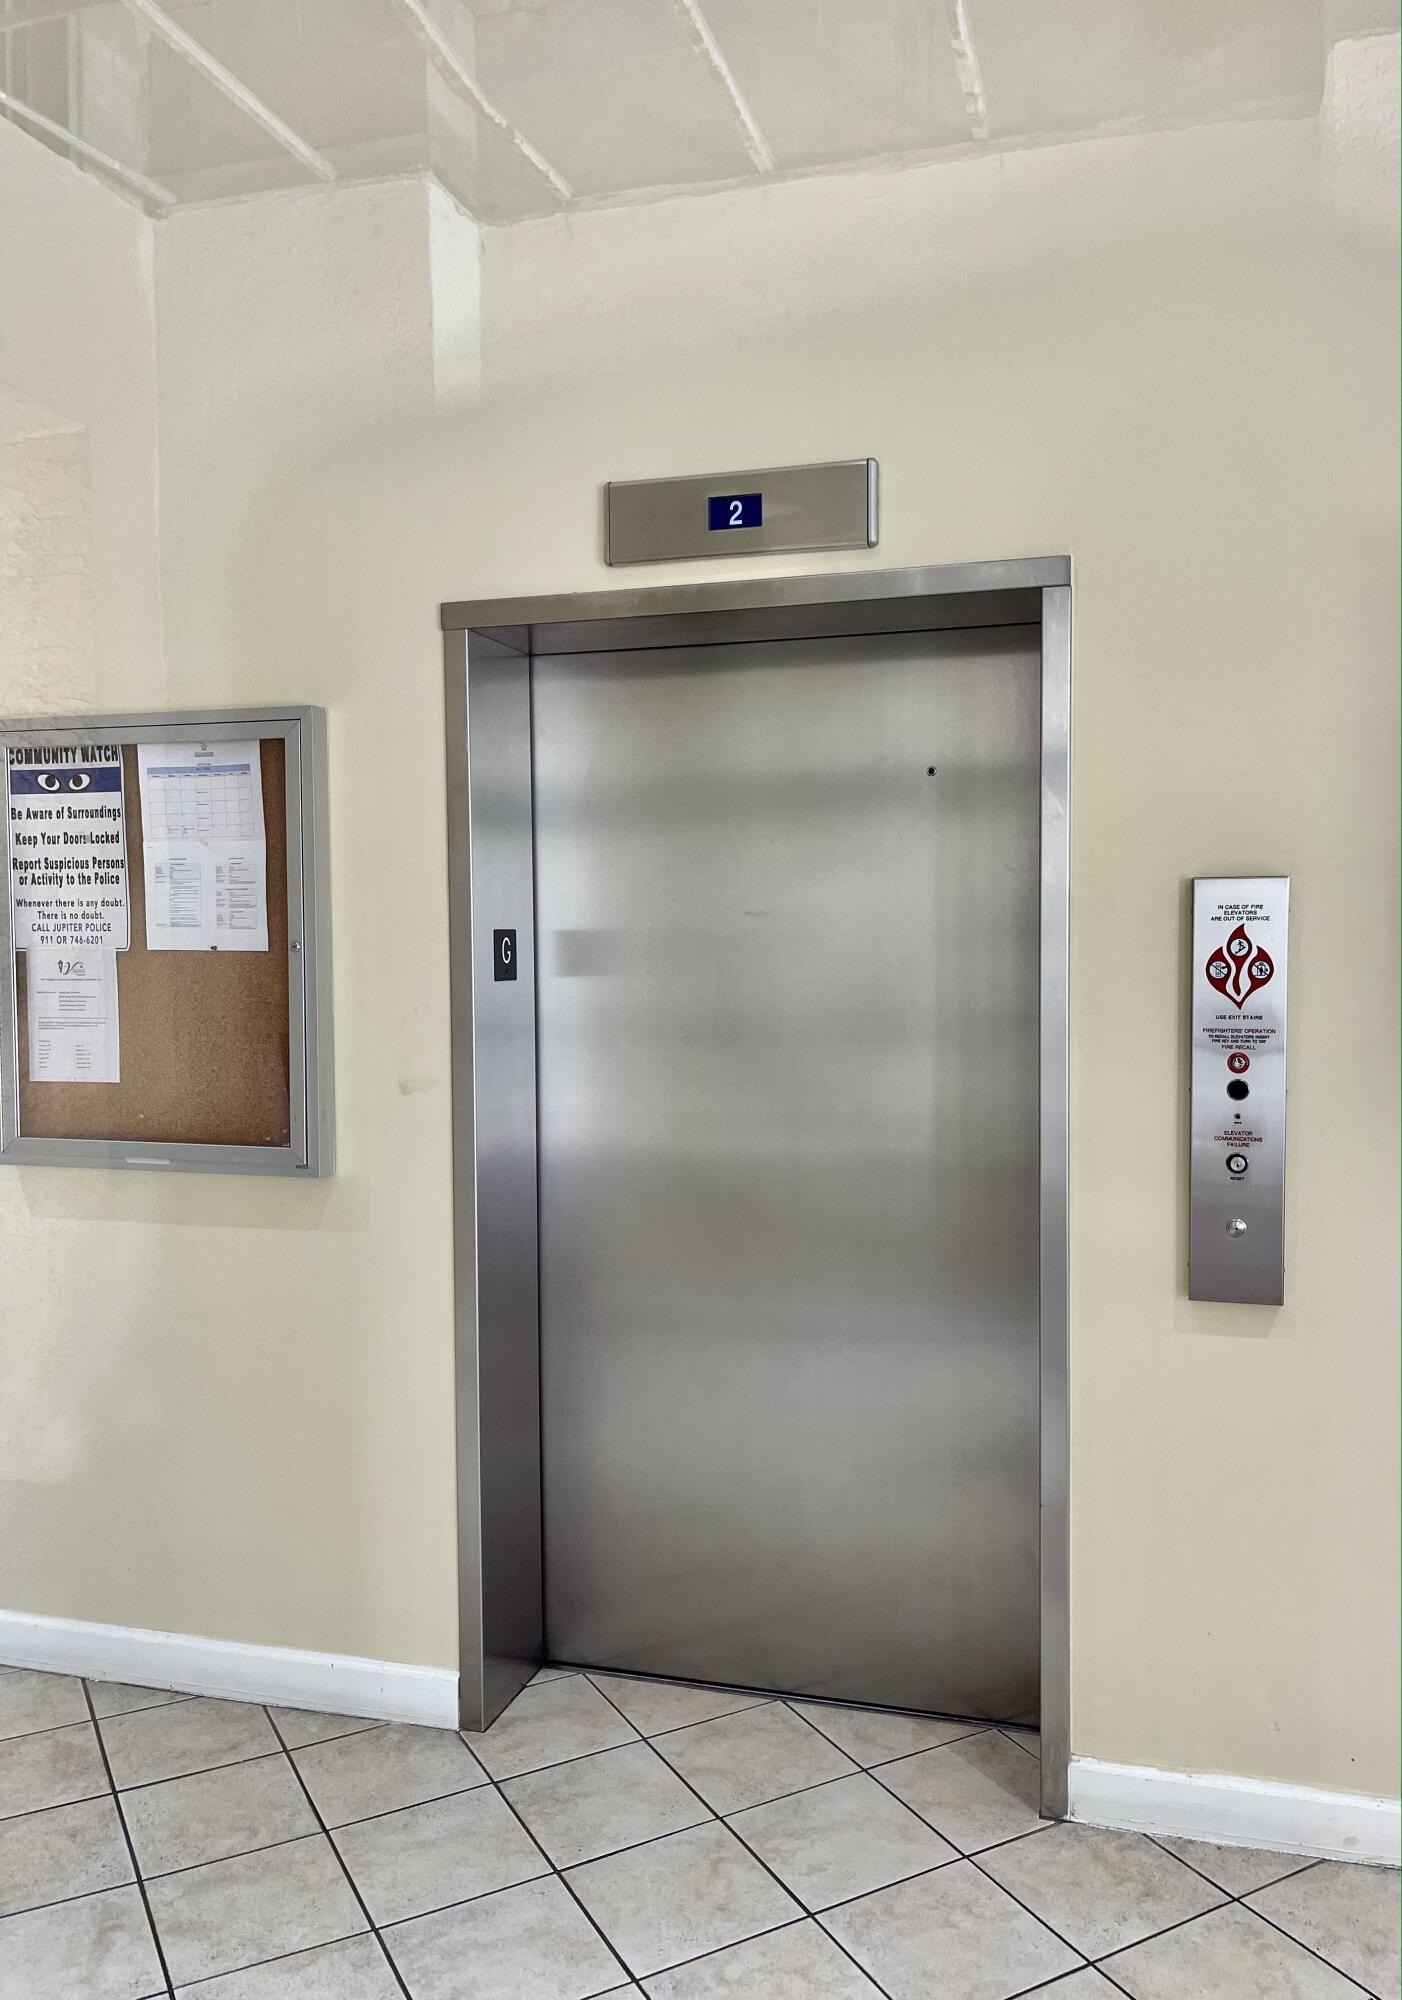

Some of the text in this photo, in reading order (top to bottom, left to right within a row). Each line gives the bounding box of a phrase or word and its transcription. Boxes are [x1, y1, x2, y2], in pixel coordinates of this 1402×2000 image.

[729, 500, 743, 526] 2
[9, 745, 119, 765] COMMUNITY WATCH
[11, 805, 121, 821] Be Aware of Surroundings
[15, 831, 120, 848] Keep Your Doors Locked
[12, 856, 125, 873] Report Suspicious Persons
[19, 872, 120, 888] or Activity to the Police
[16, 898, 125, 909] Whenever there is any doubt.
[37, 911, 58, 920] There
[61, 911, 67, 920] is
[81, 910, 105, 920] doubt.
[31, 923, 112, 932] CALL JUPITER POLICE
[40, 936, 103, 945] 911 OR 746-6201
[502, 936, 511, 964] G
